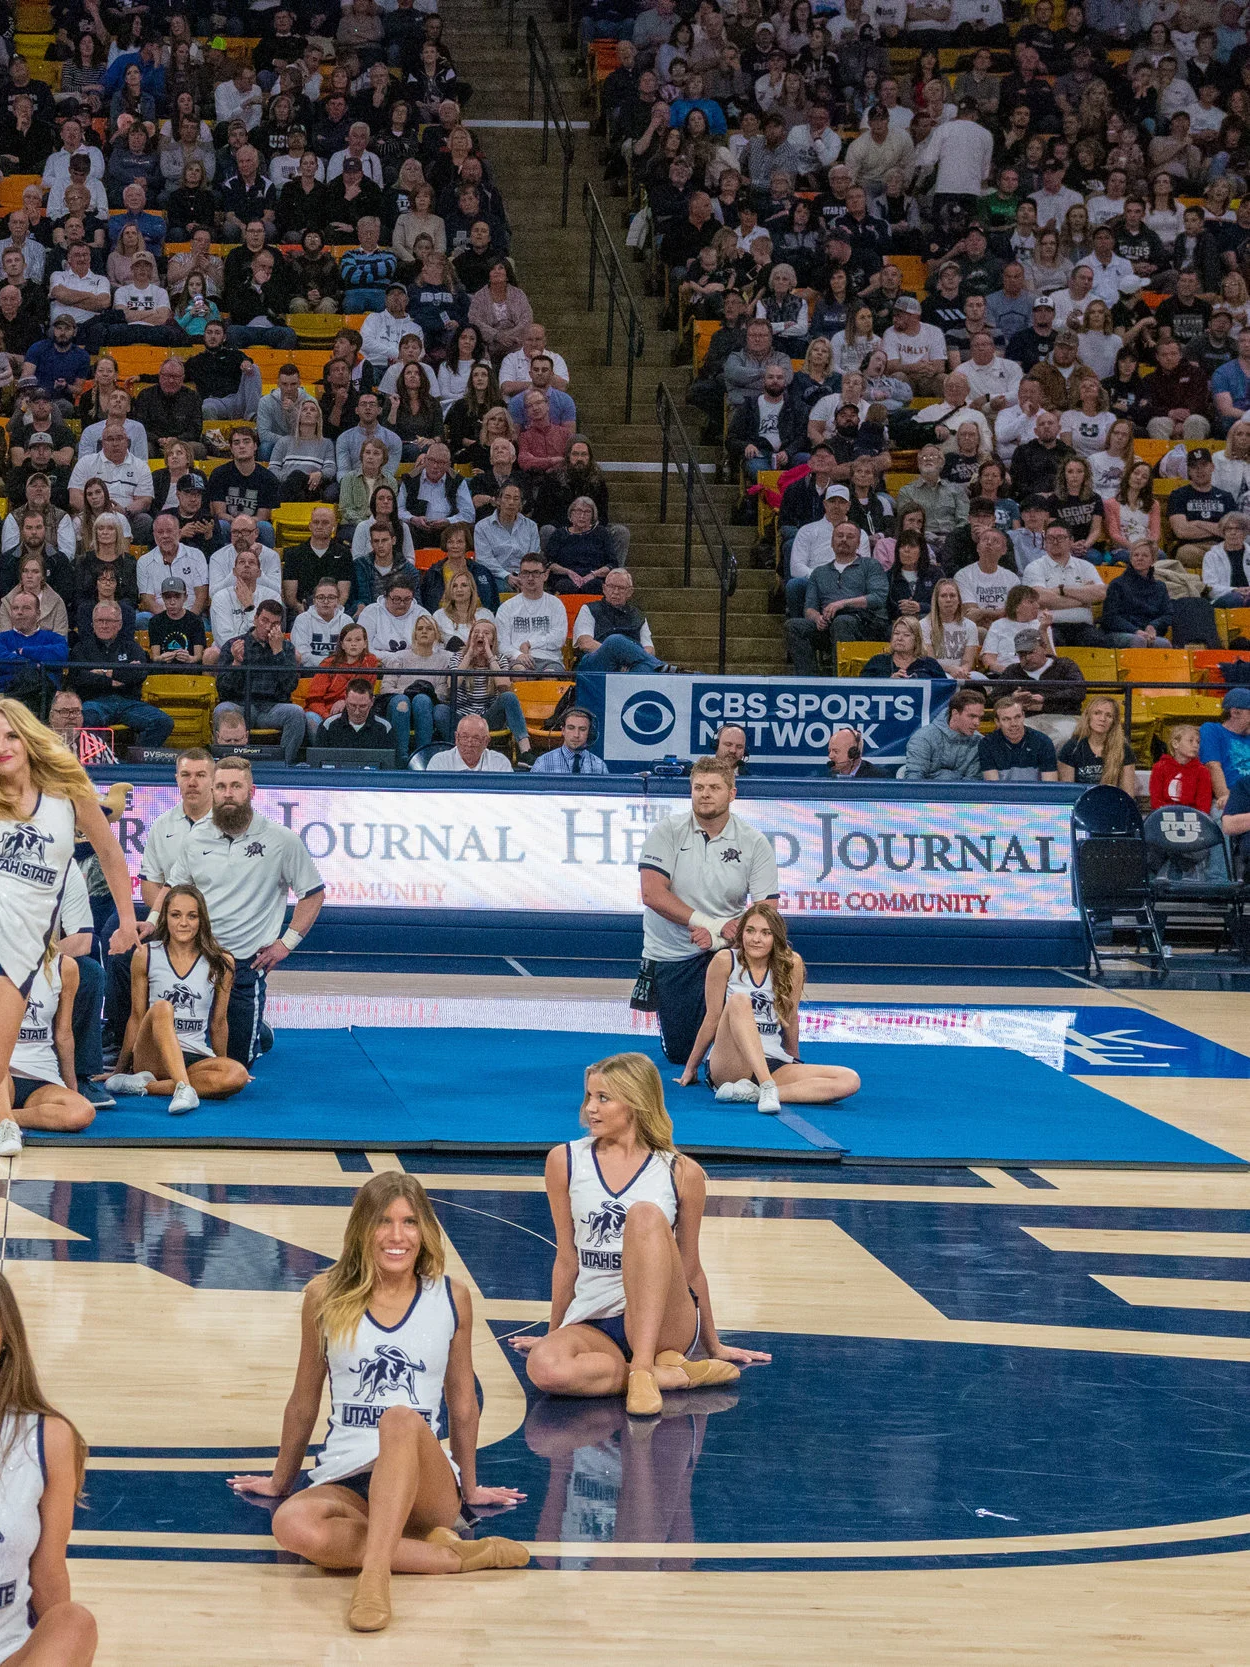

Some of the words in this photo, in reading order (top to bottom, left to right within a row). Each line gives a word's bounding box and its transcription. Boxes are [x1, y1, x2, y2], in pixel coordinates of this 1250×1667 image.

[269, 134, 289, 148] US
[980, 594, 1004, 603] HOOPS
[310, 642, 338, 652] STAT
[699, 692, 767, 718] CBS
[776, 694, 914, 721] SPORTS
[277, 802, 526, 864] JOURNAL
[1160, 820, 1202, 832] STATE
[814, 812, 1067, 884] JOURNAL
[20, 864, 58, 886] STATE
[322, 882, 447, 903] OMMUNITY
[795, 892, 840, 911] THE
[846, 892, 991, 914] COMMUNITY
[19, 1026, 48, 1040] STATE
[176, 1018, 204, 1030] STATE
[580, 1249, 608, 1270] UTAH
[342, 1403, 382, 1429] UTAH
